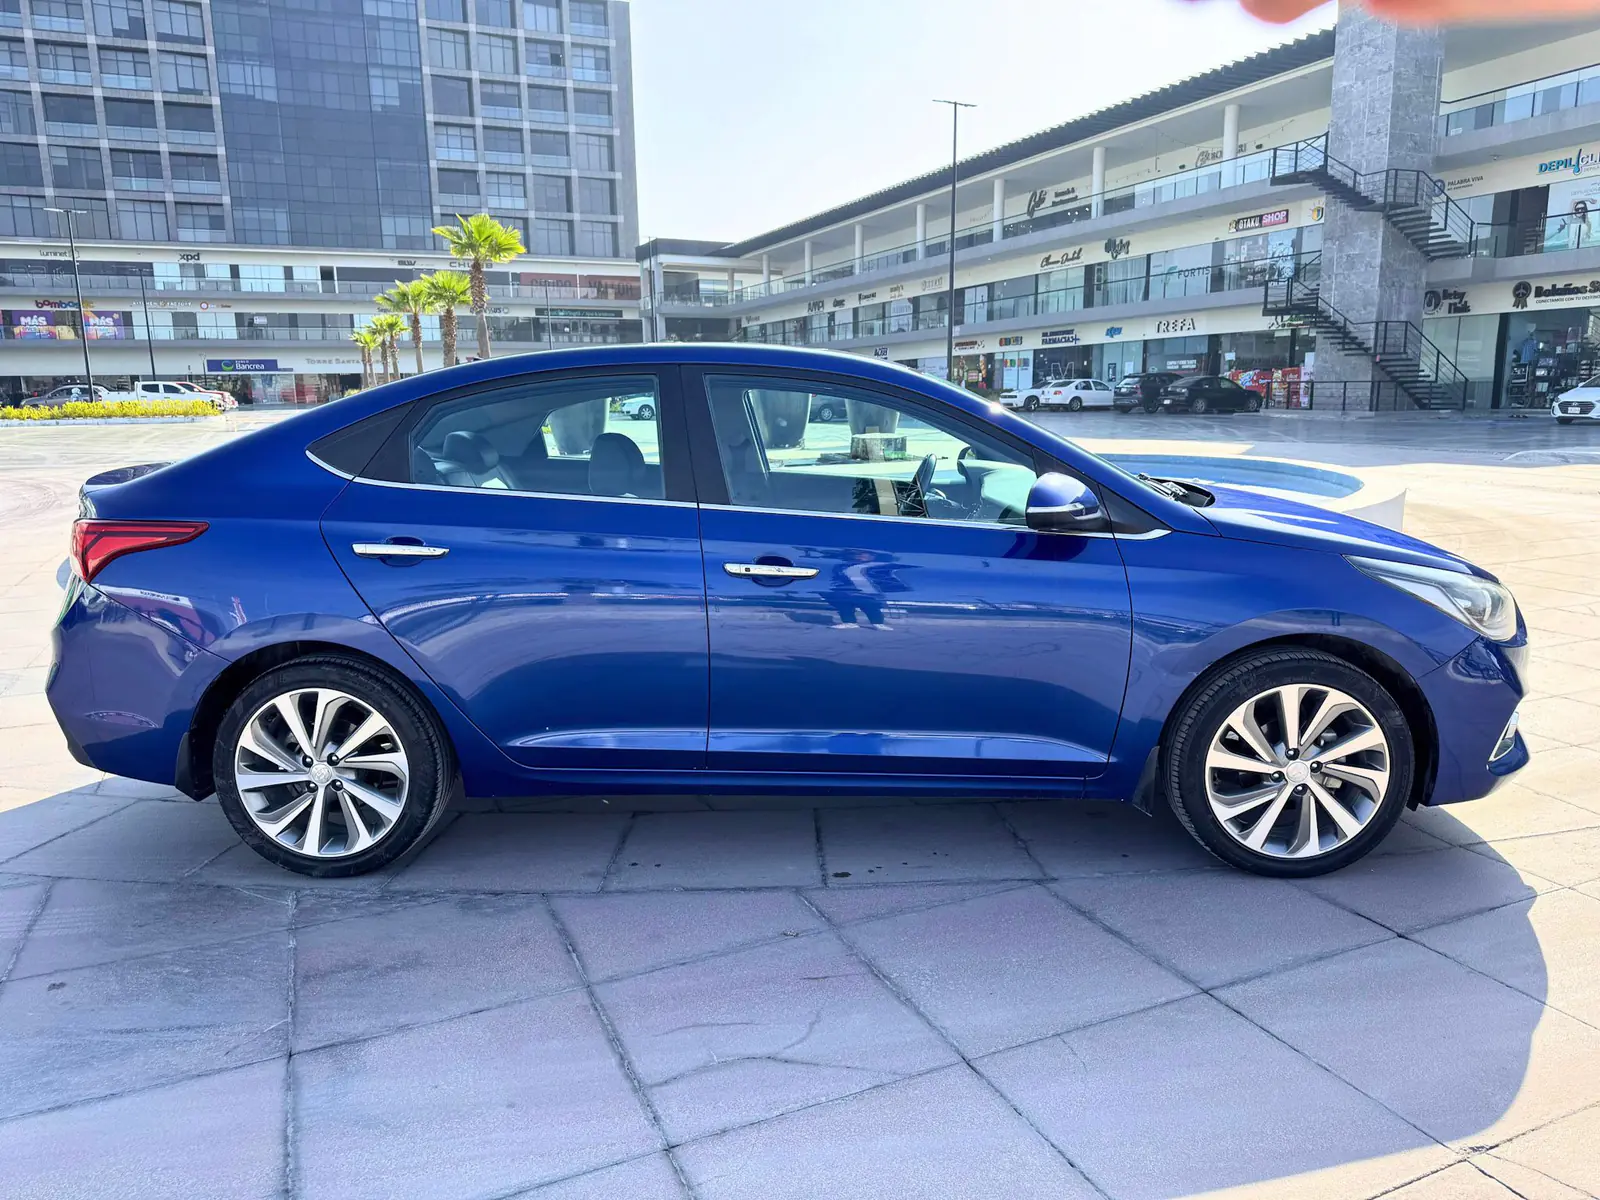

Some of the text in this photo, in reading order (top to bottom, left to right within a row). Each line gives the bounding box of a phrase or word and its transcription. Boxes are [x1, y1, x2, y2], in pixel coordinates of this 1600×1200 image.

[1538, 157, 1575, 173] DEPIL
[1447, 175, 1484, 187] PALABRA VIVA
[1239, 210, 1287, 230] OTAKU SHOP
[179, 252, 201, 262] xpd
[1177, 265, 1211, 279] FORTIS
[20, 314, 47, 326] MÁS
[90, 315, 114, 326] MÁS
[1155, 318, 1196, 333] TREFA
[235, 362, 265, 370] Bancrea
